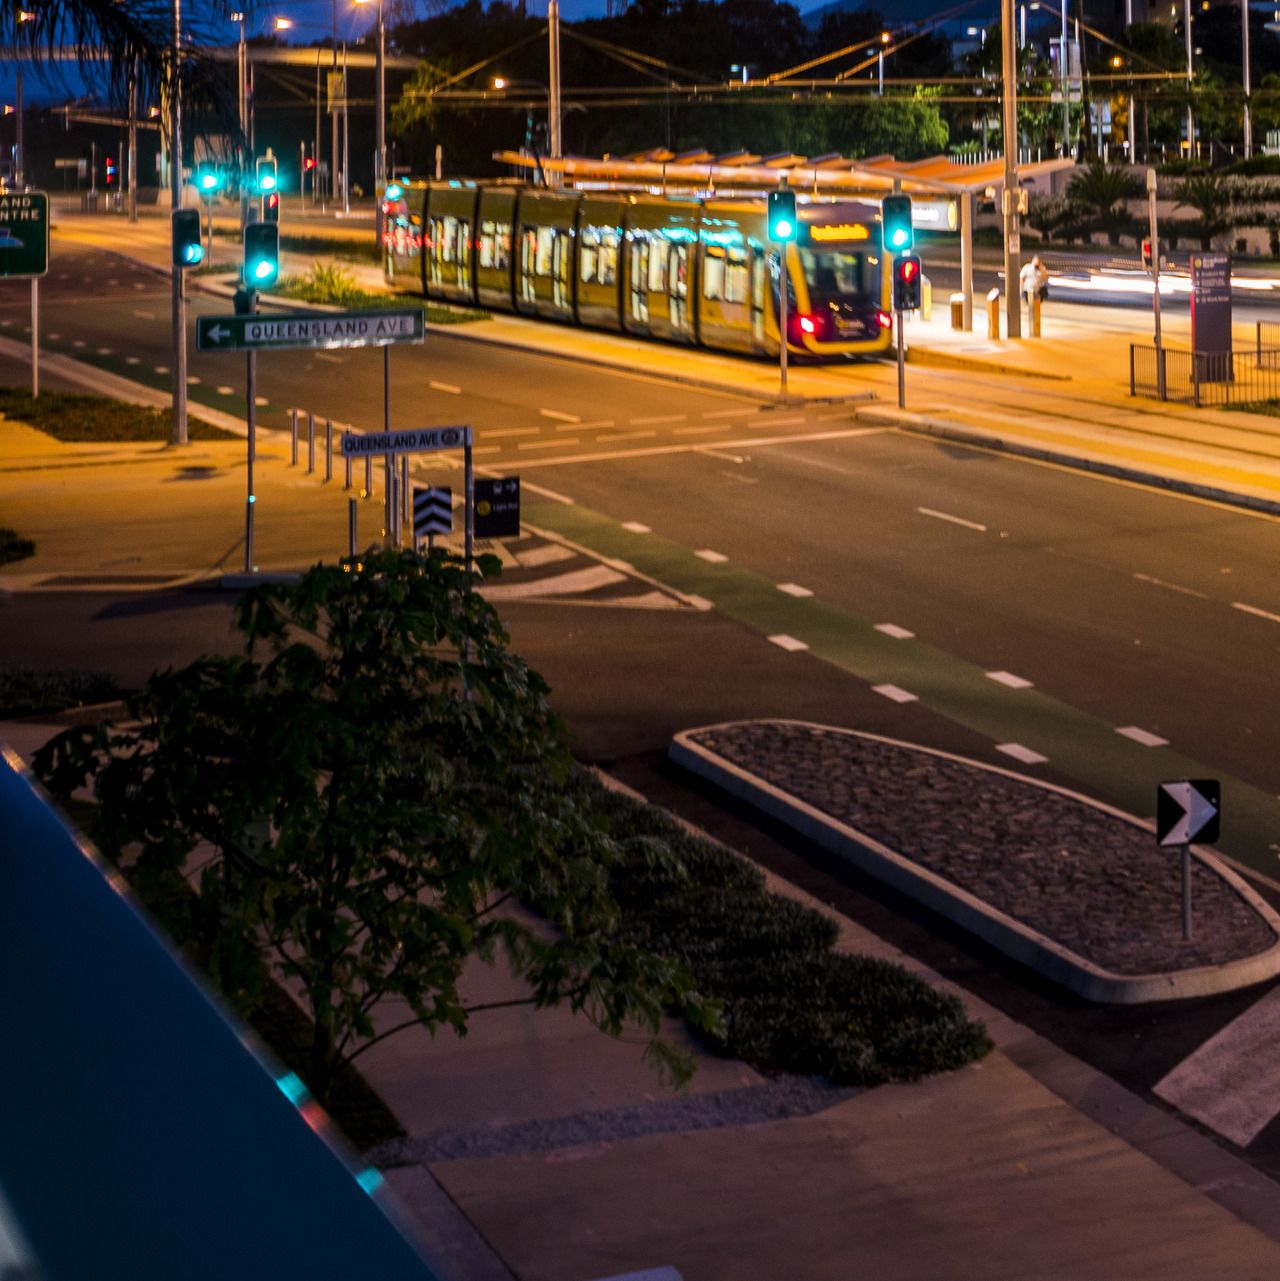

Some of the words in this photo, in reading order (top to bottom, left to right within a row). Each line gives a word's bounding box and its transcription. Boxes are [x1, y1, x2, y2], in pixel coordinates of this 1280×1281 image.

[0, 209, 39, 221] NTRE
[251, 320, 368, 339] QUEENSLAND
[376, 317, 411, 335] AVE
[345, 435, 416, 452] QUEENSLAND
[419, 434, 438, 446] AVE
